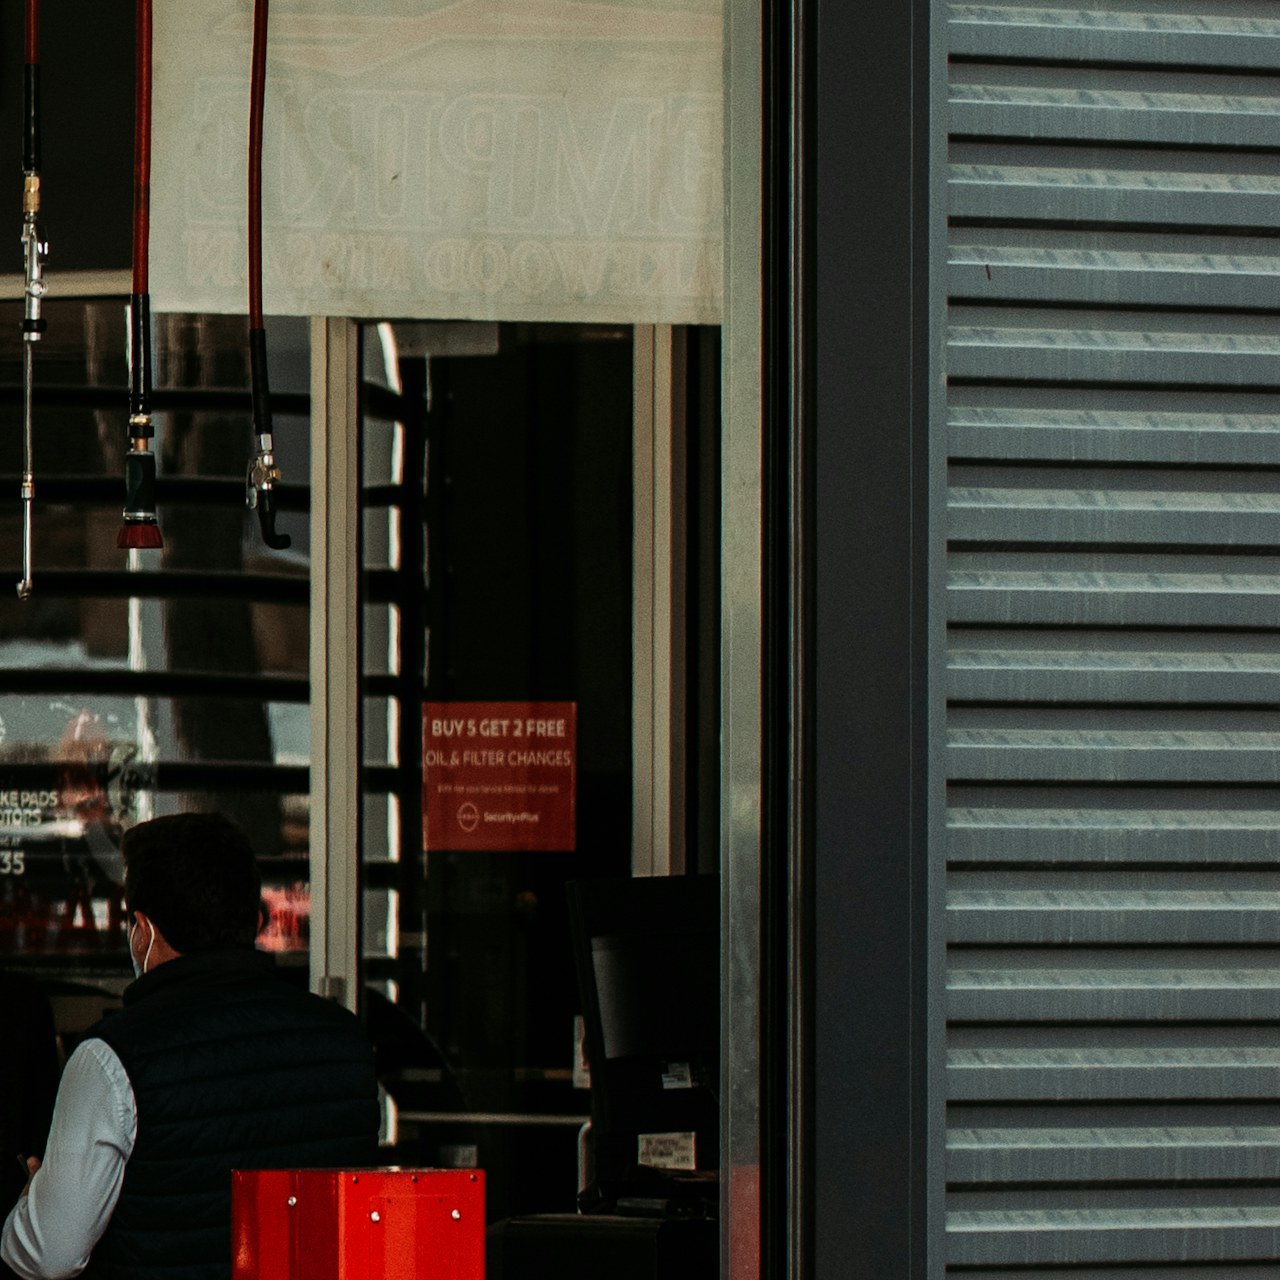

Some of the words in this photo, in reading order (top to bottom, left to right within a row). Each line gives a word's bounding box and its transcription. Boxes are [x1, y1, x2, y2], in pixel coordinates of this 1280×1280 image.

[431, 718, 464, 737] BUY
[466, 718, 476, 737] 5
[479, 718, 510, 737] GET
[513, 718, 522, 737] 2
[526, 718, 566, 737] FREE
[425, 750, 448, 766] OIL
[450, 751, 460, 766] &
[463, 750, 504, 766] FILTER
[507, 750, 571, 767] CHANGES
[20, 790, 59, 809] PADS
